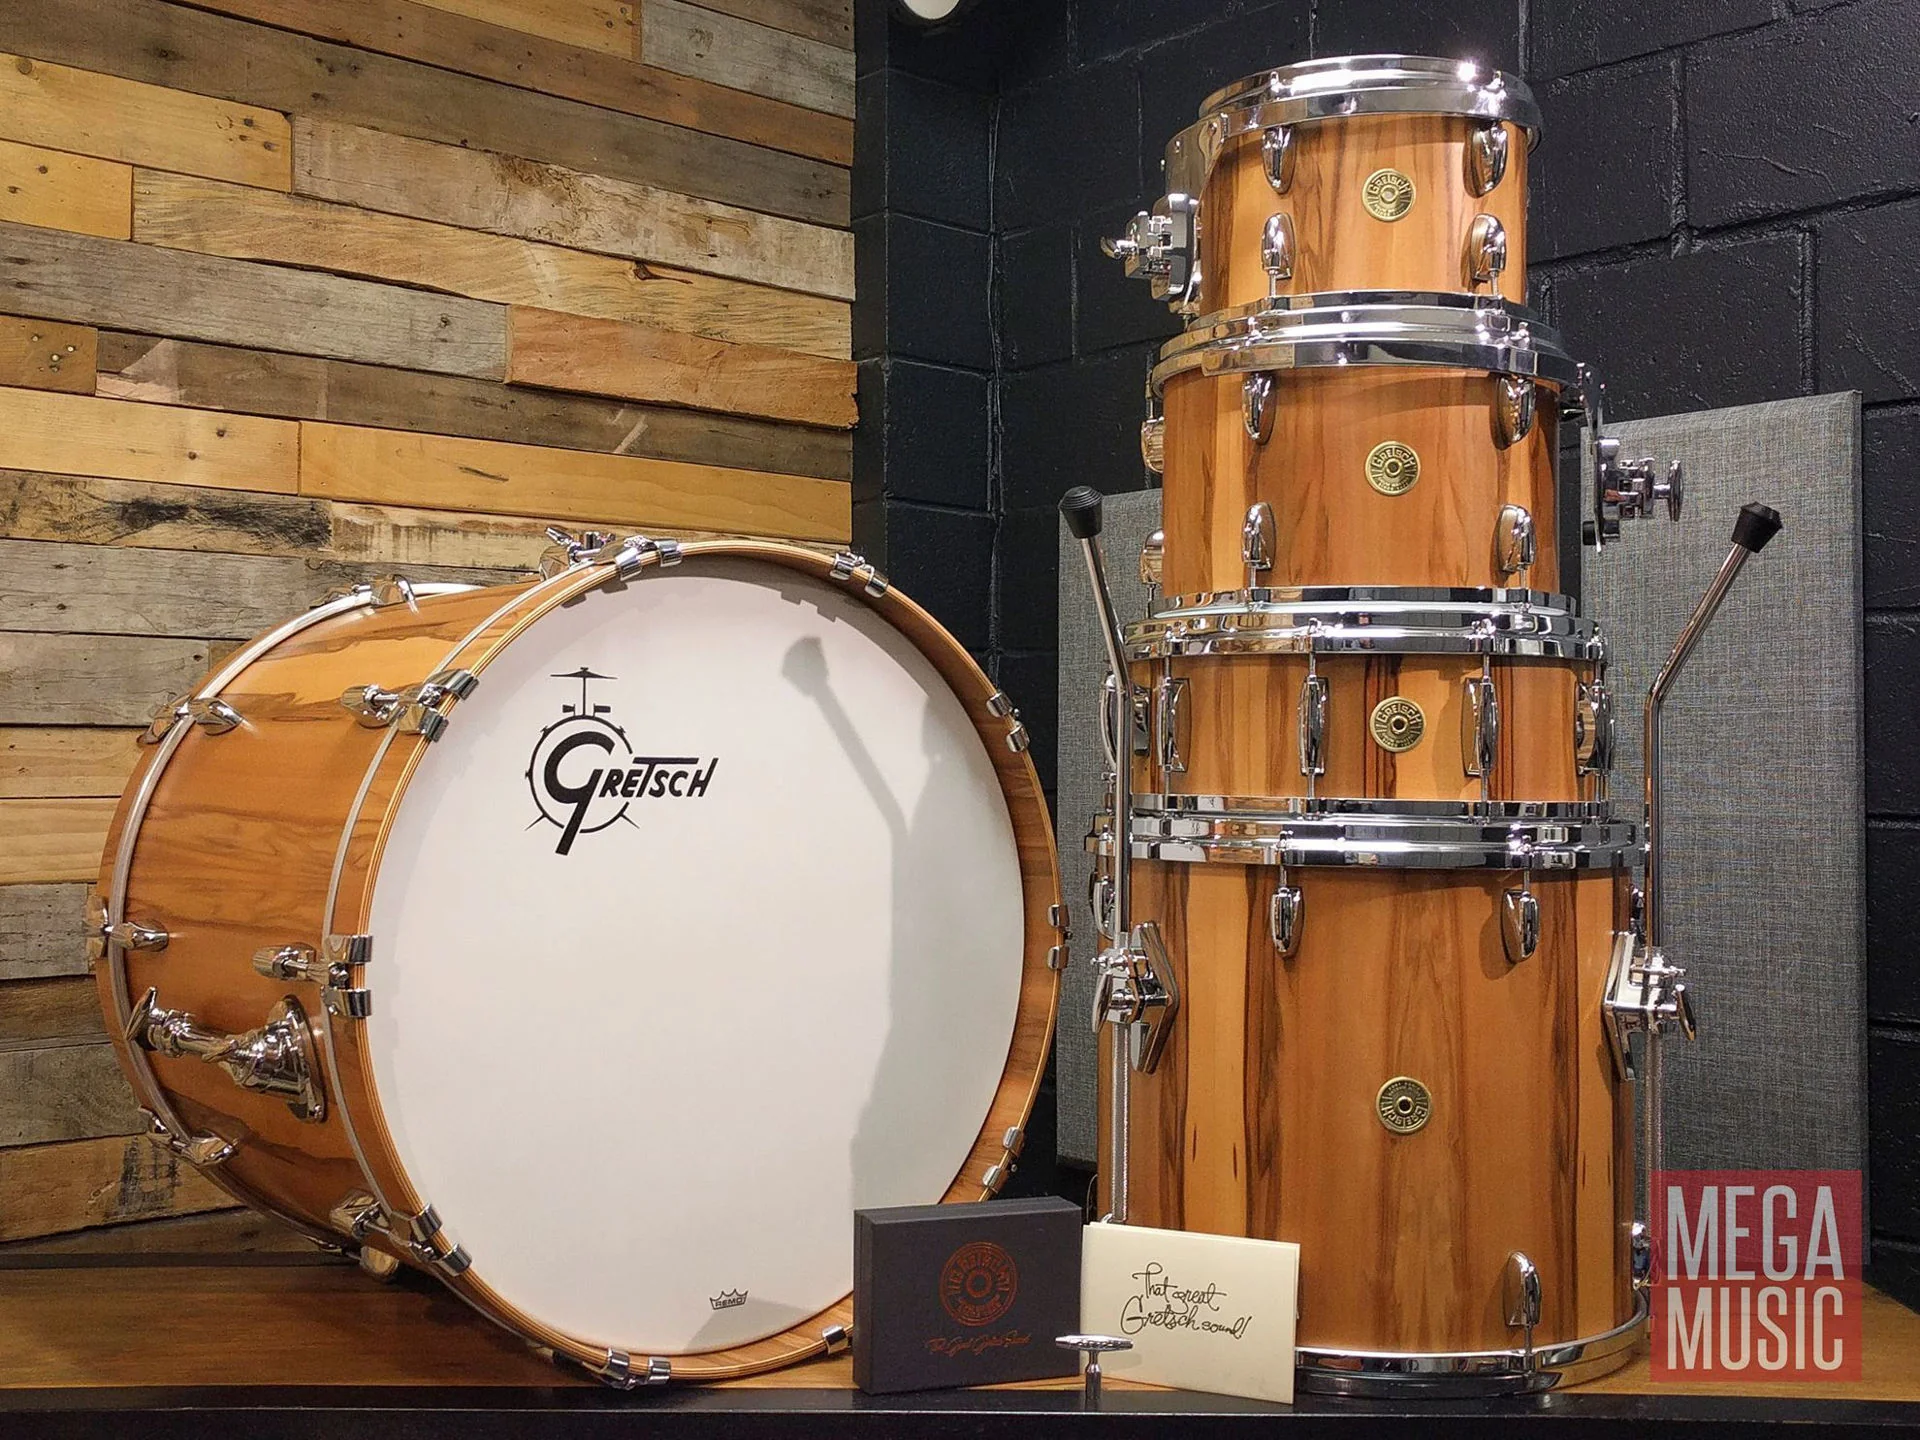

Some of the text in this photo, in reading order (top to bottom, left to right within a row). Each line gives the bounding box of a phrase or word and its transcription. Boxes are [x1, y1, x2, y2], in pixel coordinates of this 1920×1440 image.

[544, 731, 719, 856] GRETSCH
[715, 1297, 743, 1307] REMO
[1132, 1262, 1227, 1315] That great
[1120, 1294, 1252, 1340] Gretsch sound!
